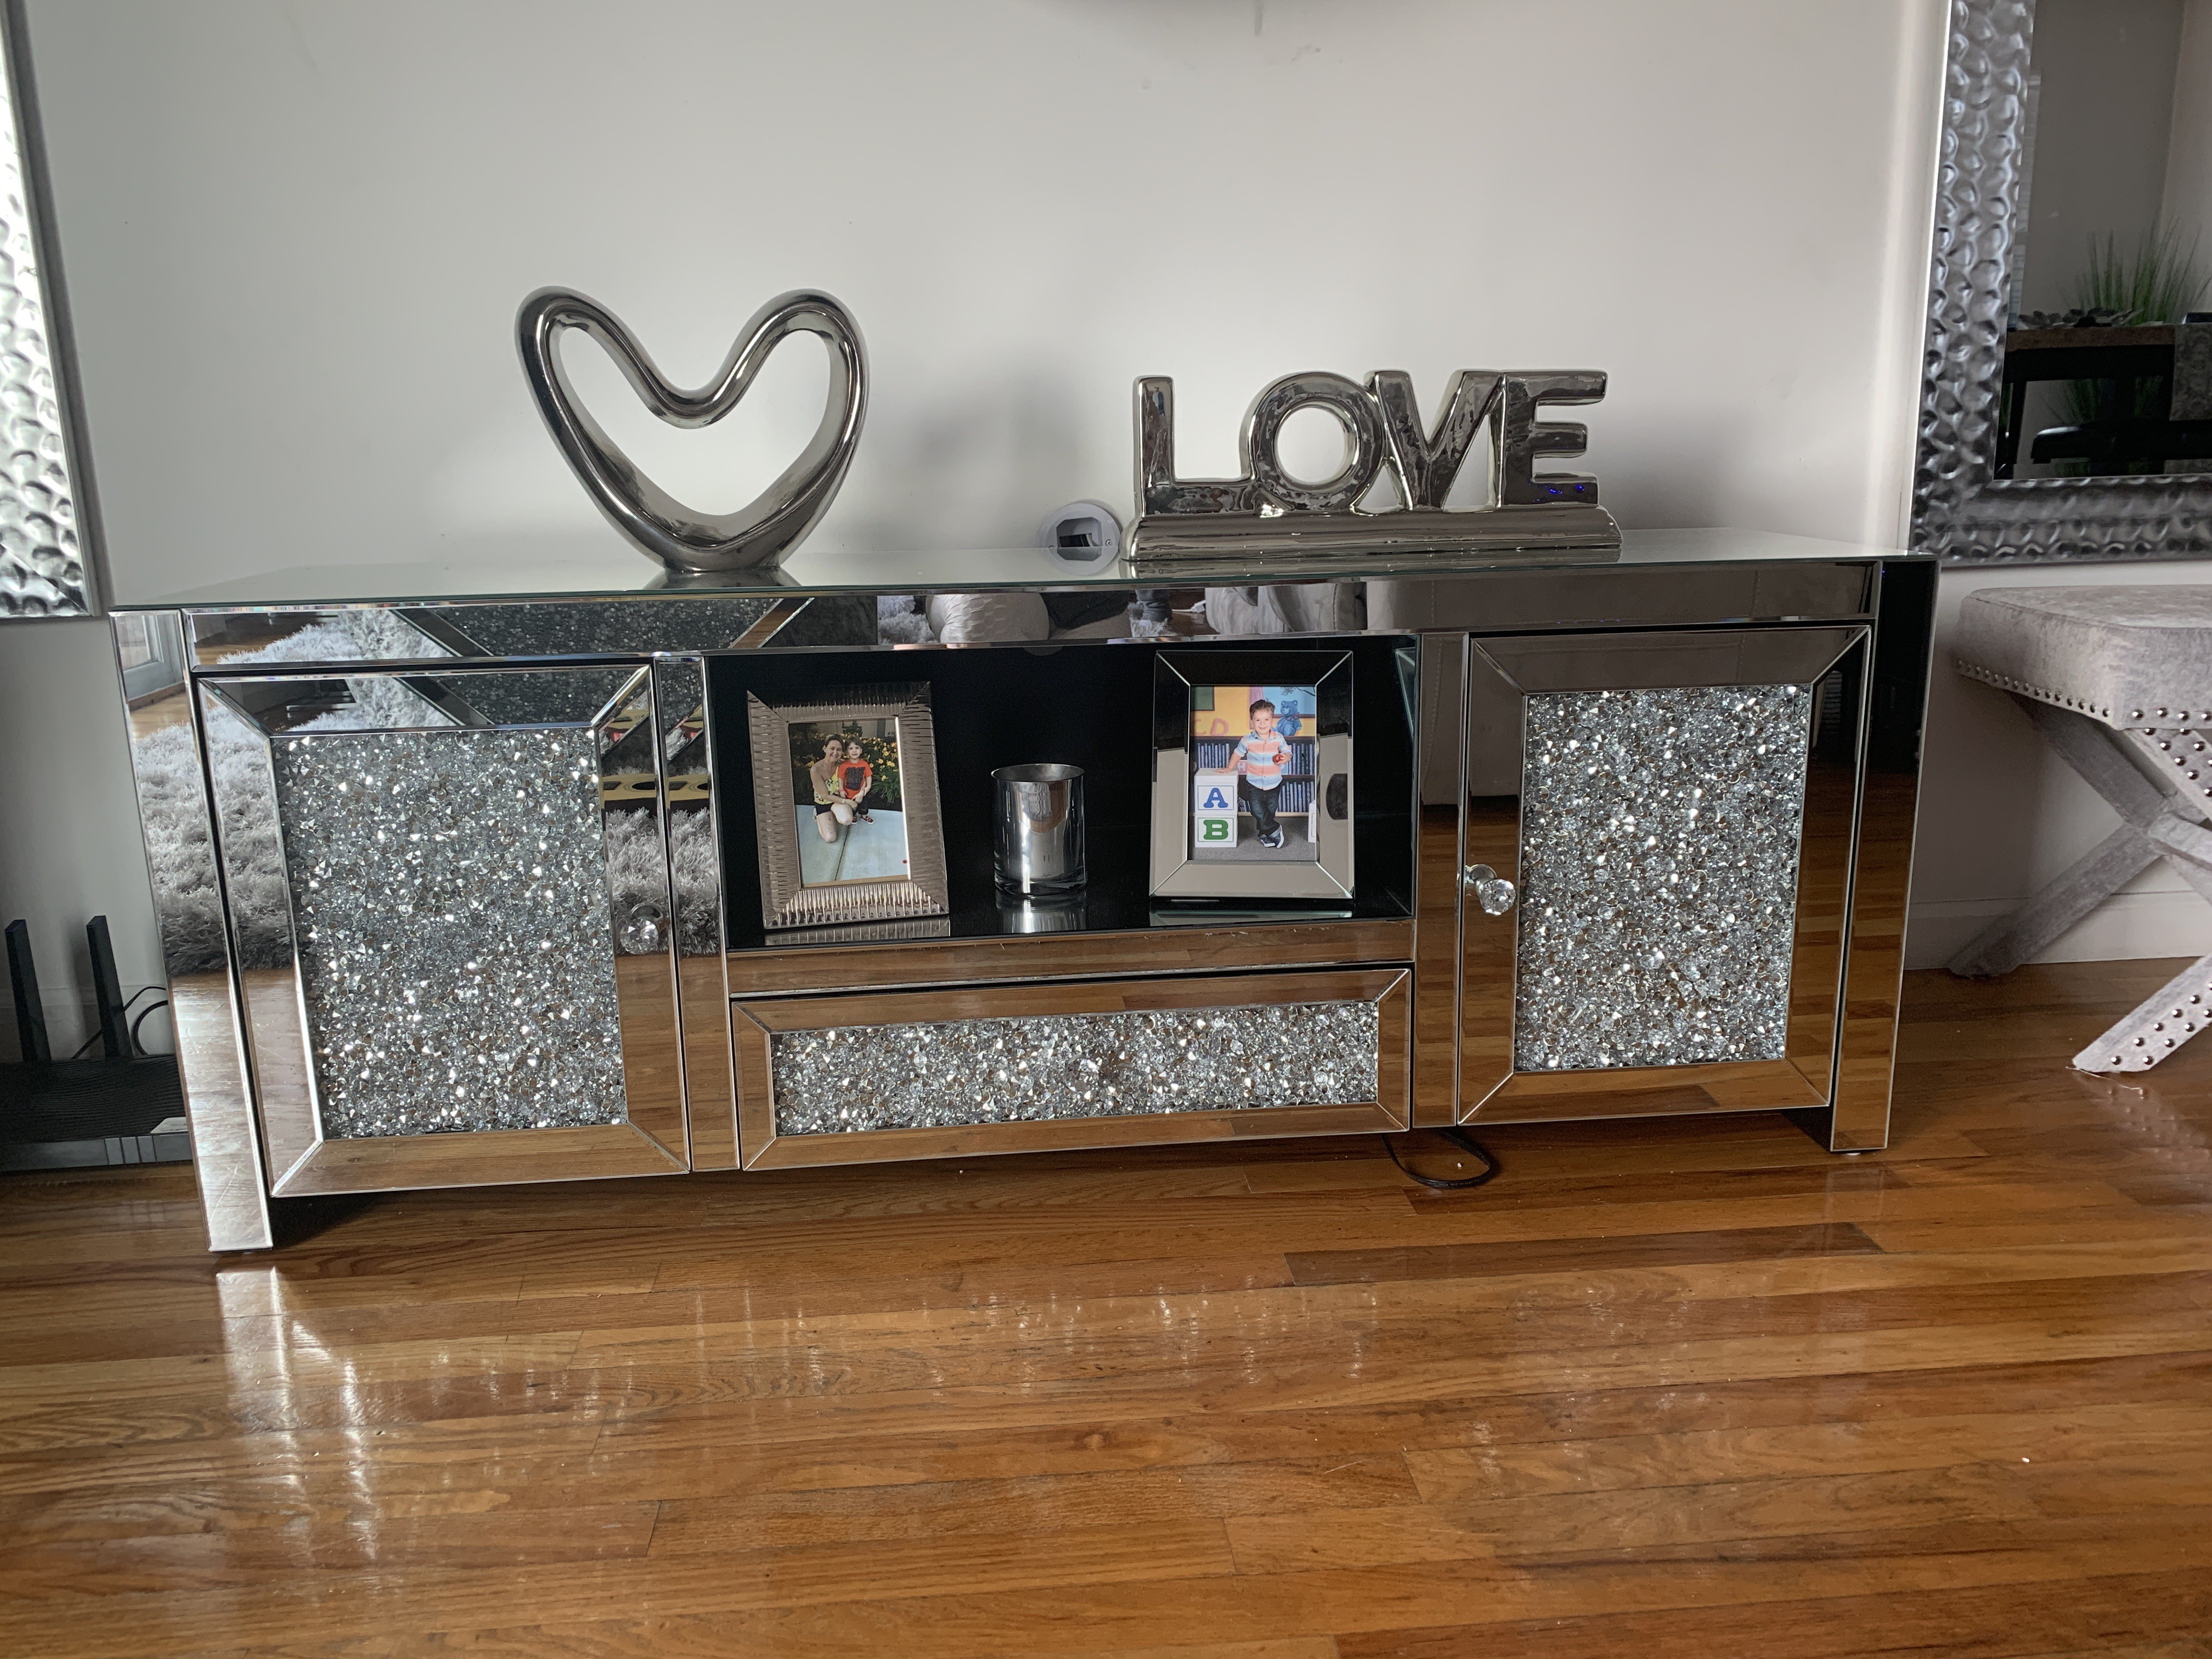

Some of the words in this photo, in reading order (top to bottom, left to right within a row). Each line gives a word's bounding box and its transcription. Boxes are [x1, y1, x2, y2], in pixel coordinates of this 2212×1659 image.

[1133, 369, 1608, 517] LOVE
[1203, 787, 1228, 808] A
[1203, 820, 1228, 840] B
